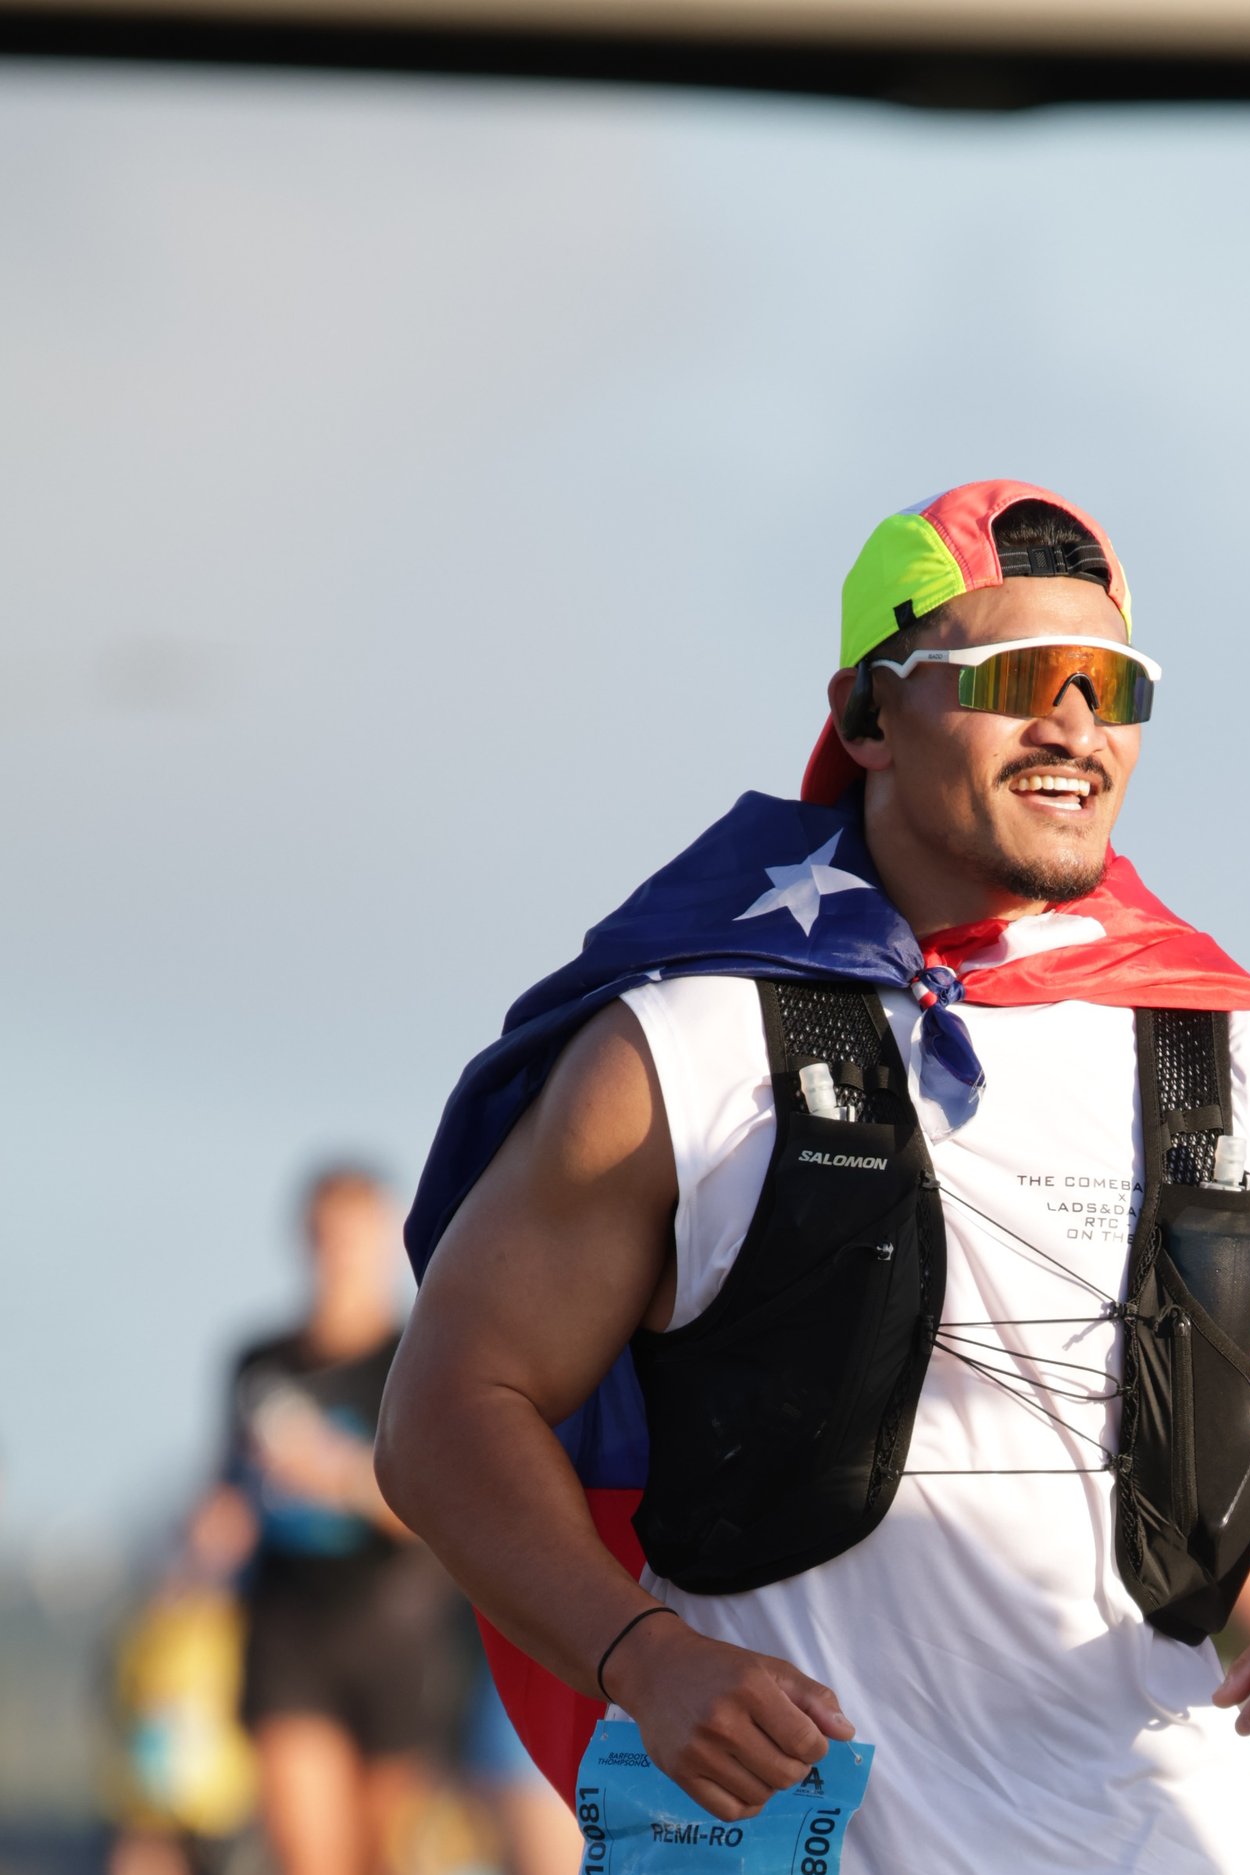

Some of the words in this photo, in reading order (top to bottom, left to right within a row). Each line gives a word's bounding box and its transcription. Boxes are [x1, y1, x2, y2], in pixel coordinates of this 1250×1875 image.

[798, 1149, 888, 1171] SALOMON
[1017, 1175, 1055, 1187] THE
[1064, 1176, 1144, 1193] COMEBA
[1047, 1202, 1143, 1218] LADS&DA
[1084, 1216, 1119, 1229] RTC
[1066, 1228, 1093, 1241] ON
[1101, 1230, 1134, 1245] THE
[598, 1757, 641, 1767] THOMPSON
[608, 1752, 643, 1760] BARFOOT
[650, 1823, 743, 1848] REMI-RO
